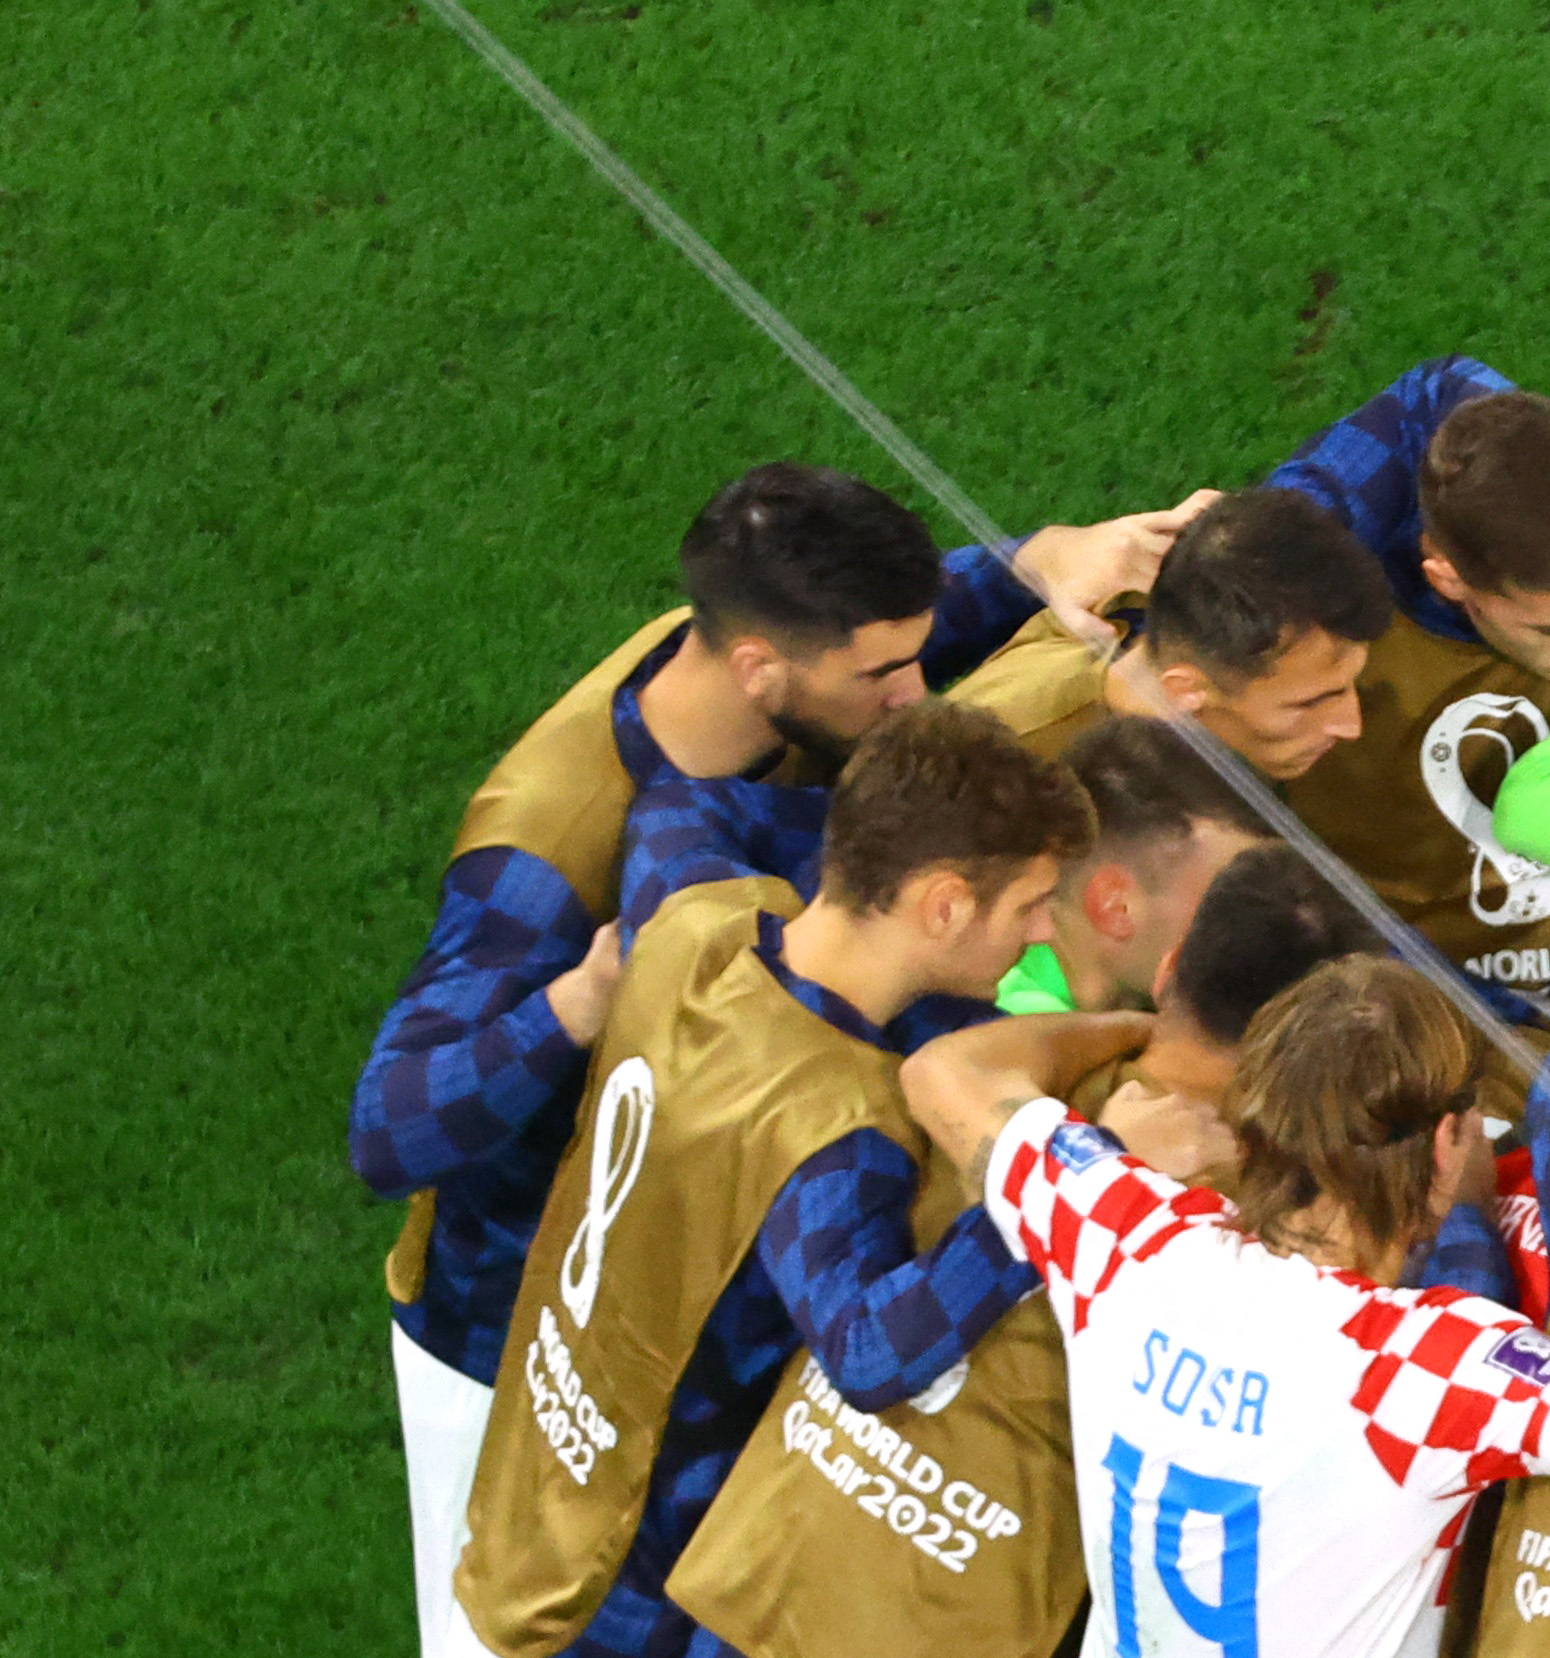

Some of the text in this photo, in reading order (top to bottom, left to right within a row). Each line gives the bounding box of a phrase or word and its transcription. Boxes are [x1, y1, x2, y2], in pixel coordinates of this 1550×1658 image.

[1133, 1329, 1270, 1437] SOSA
[834, 1402, 944, 1494] WORLD
[942, 1480, 1022, 1540] CUP
